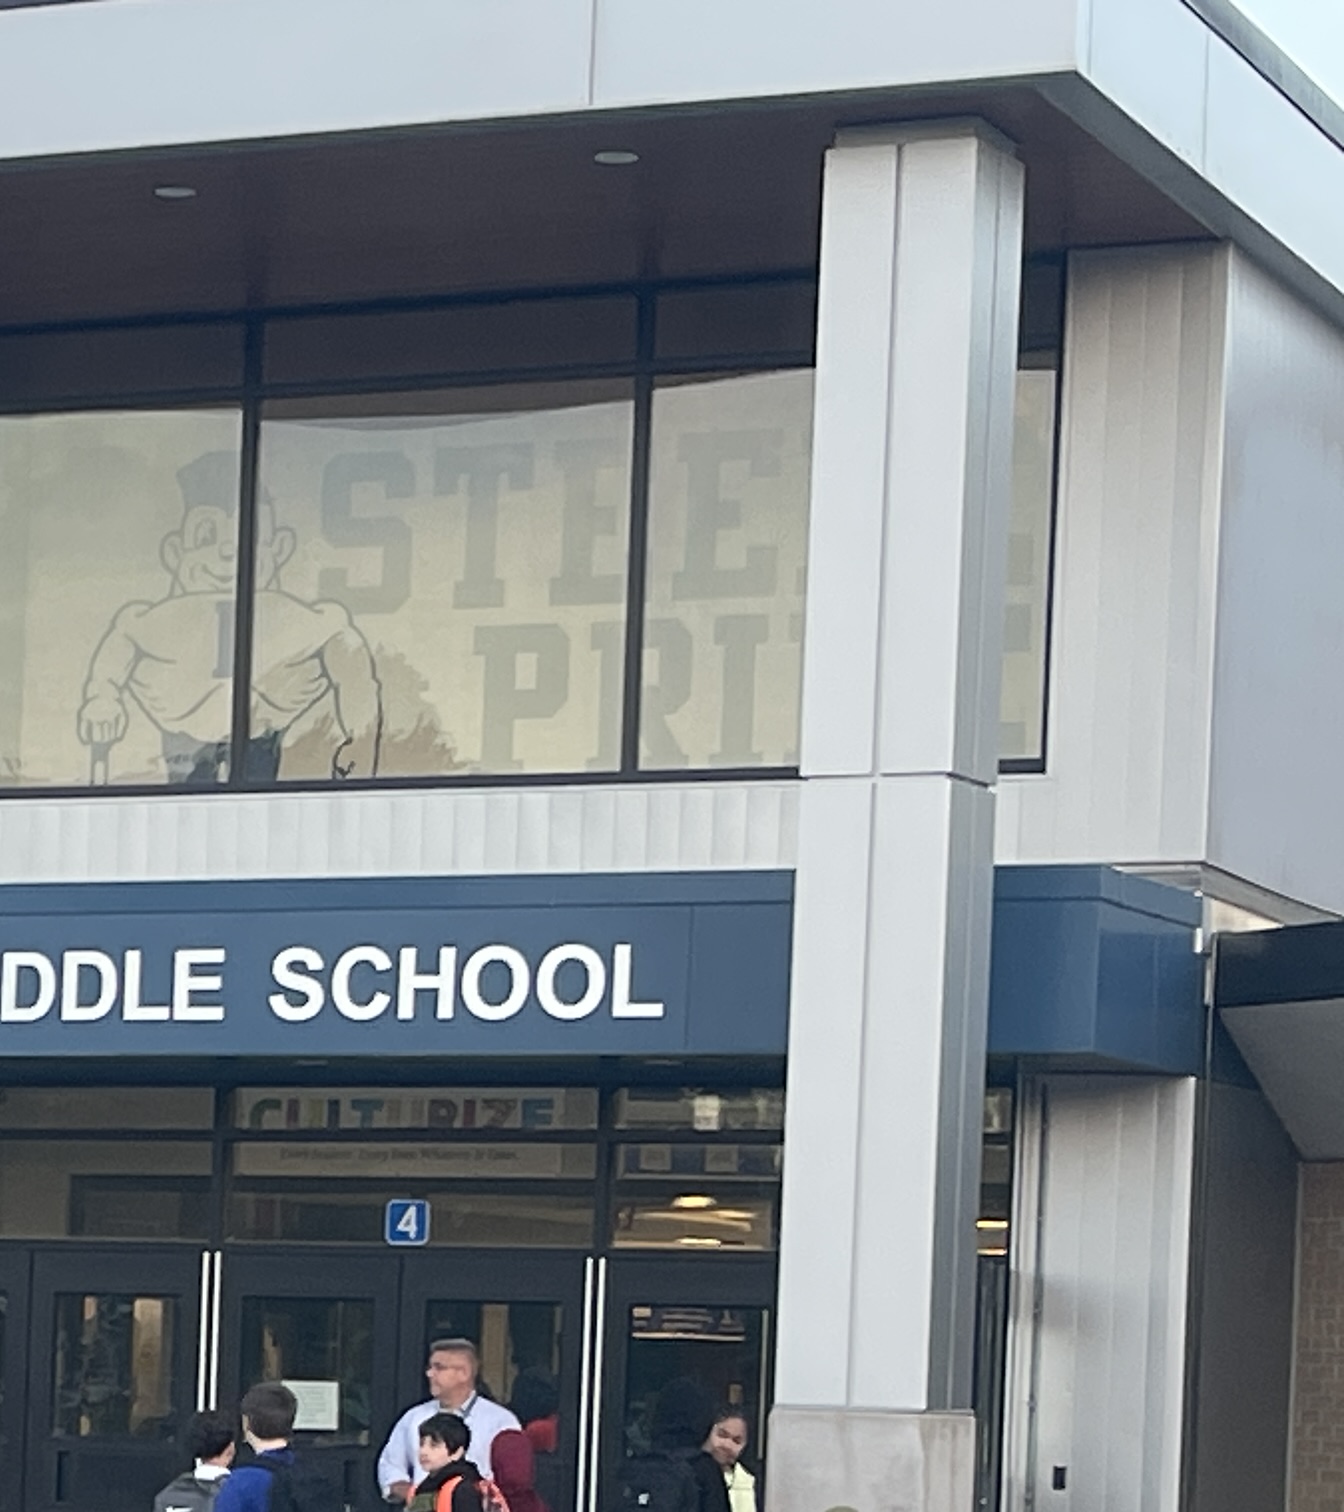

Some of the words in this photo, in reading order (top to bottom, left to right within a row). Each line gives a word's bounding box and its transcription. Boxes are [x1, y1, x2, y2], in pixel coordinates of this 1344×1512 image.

[318, 429, 806, 614] STEE
[472, 612, 800, 772] PRI
[268, 943, 664, 1022] SCHOOL
[396, 1204, 418, 1240] 4
